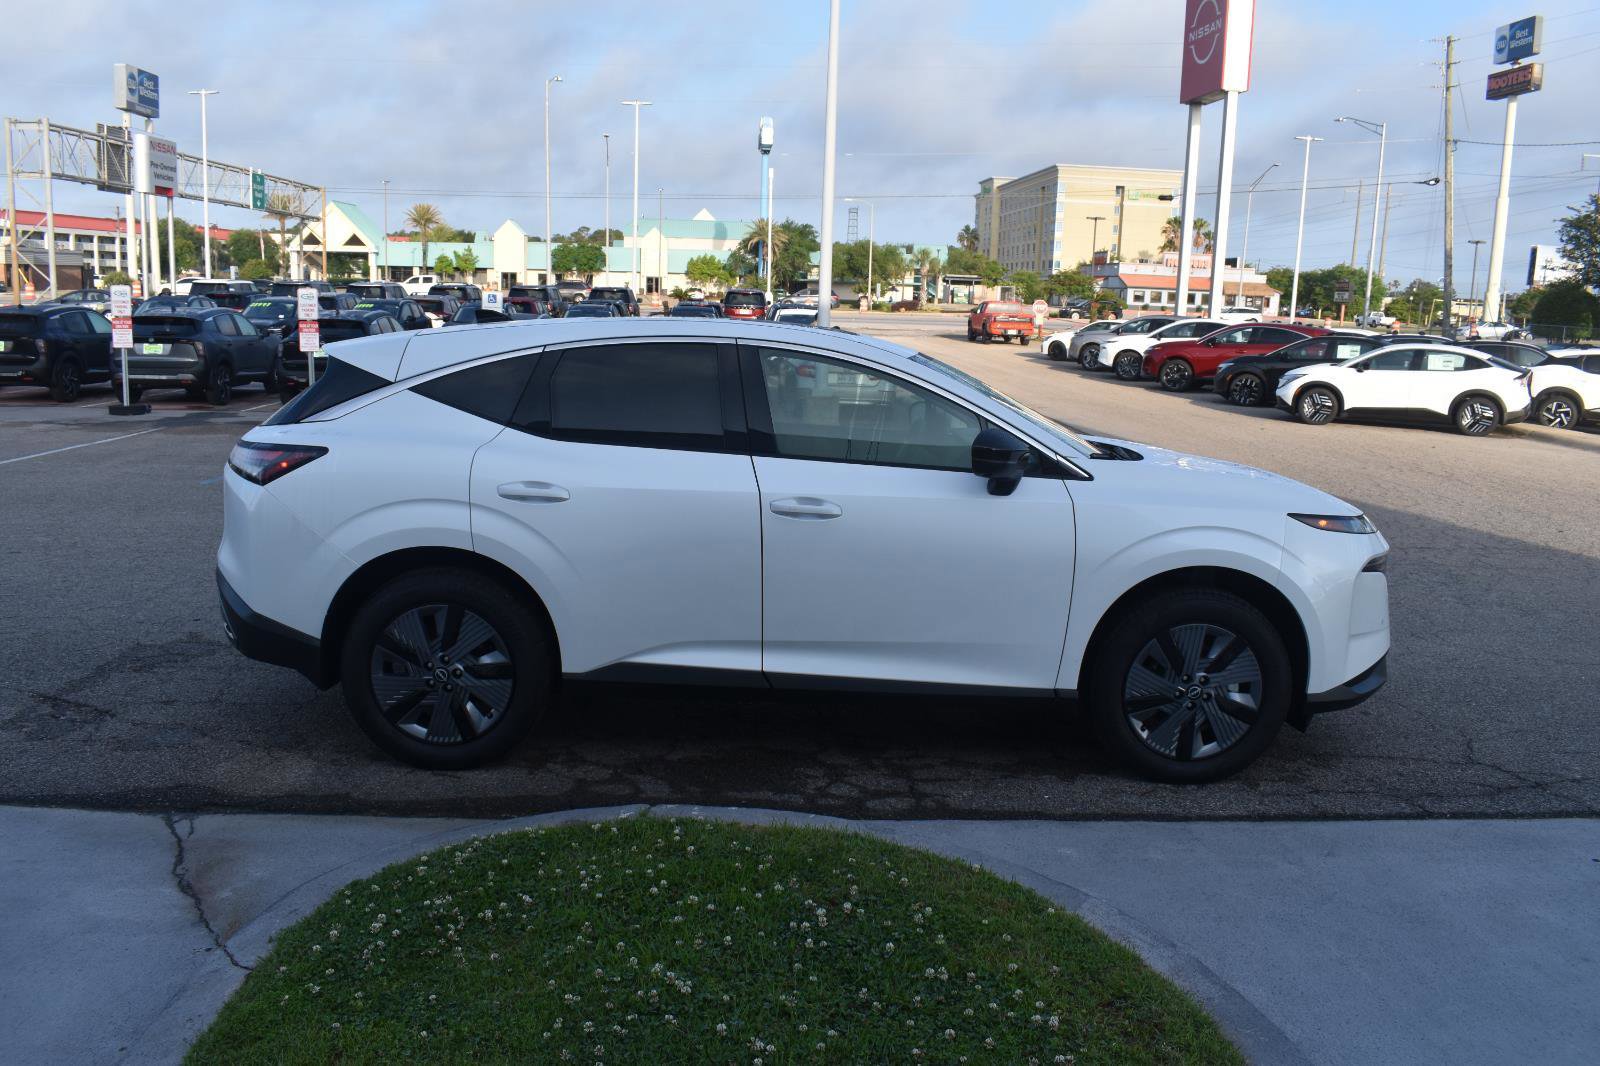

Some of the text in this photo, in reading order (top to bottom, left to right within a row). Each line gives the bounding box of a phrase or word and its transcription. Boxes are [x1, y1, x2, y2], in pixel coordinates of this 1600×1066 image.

[1189, 17, 1222, 43] NISSAN
[1515, 28, 1528, 39] Best
[1510, 35, 1533, 49] Western
[143, 77, 154, 90] Best
[139, 86, 158, 100] Western
[150, 140, 176, 155] NISSAN
[150, 160, 177, 173] Pre-Owned
[153, 170, 174, 182] Vehicles
